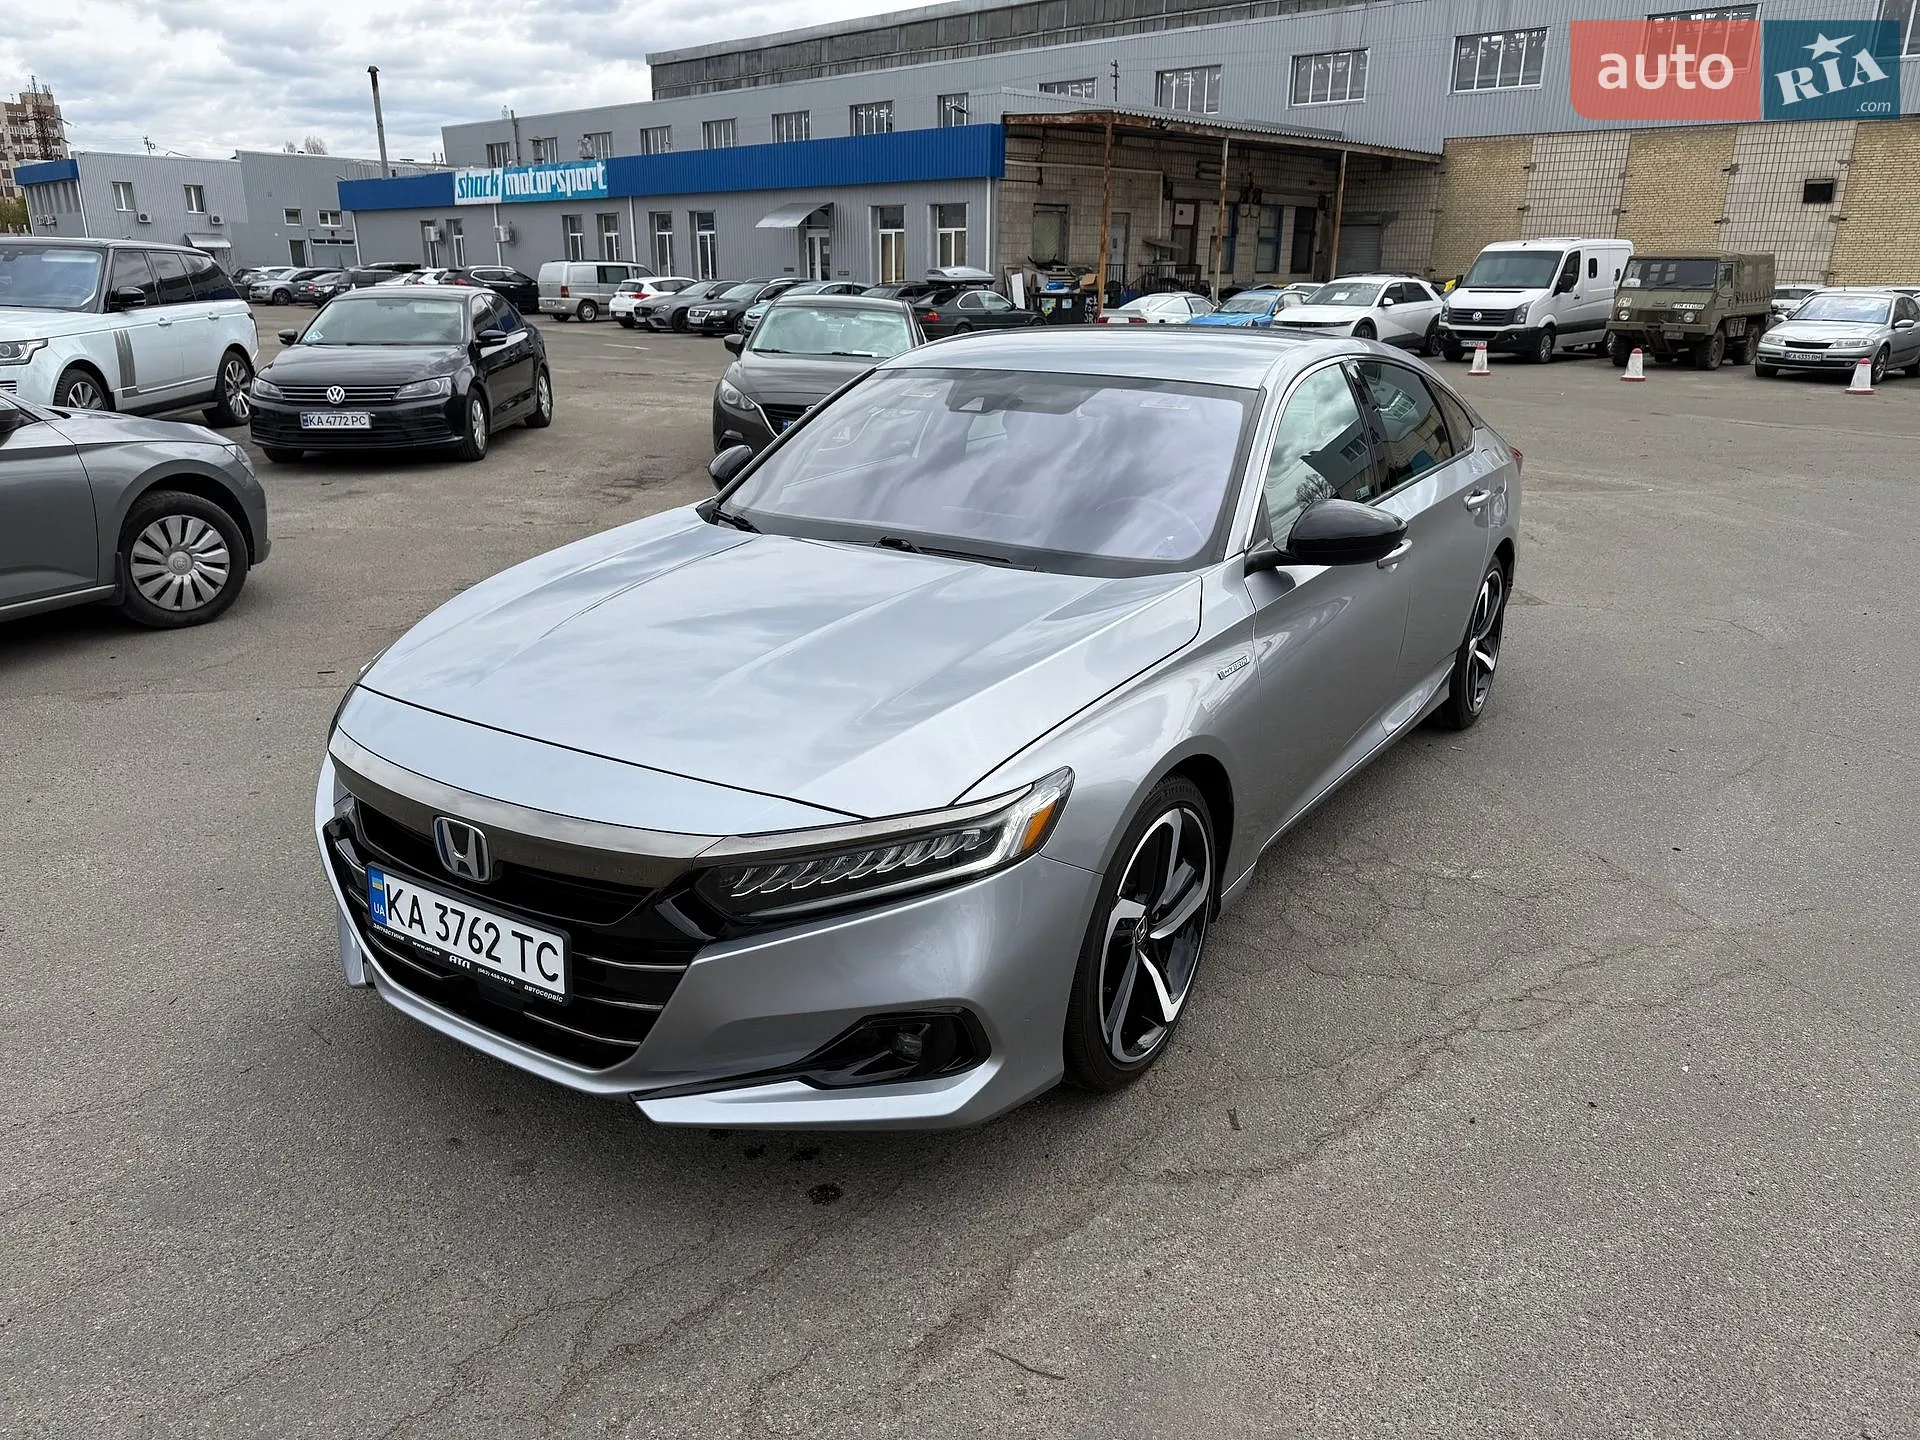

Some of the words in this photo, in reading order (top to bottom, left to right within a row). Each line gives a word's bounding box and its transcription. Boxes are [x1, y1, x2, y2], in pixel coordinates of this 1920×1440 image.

[457, 169, 499, 199] shock
[504, 162, 607, 197] motorsport
[308, 415, 324, 427] KA
[325, 415, 350, 427] 4772
[351, 415, 366, 427] PC
[373, 905, 386, 917] UA
[385, 883, 427, 935] KA
[434, 901, 502, 963] 3762
[511, 929, 559, 983] TC
[524, 984, 563, 1003] автосервіс
